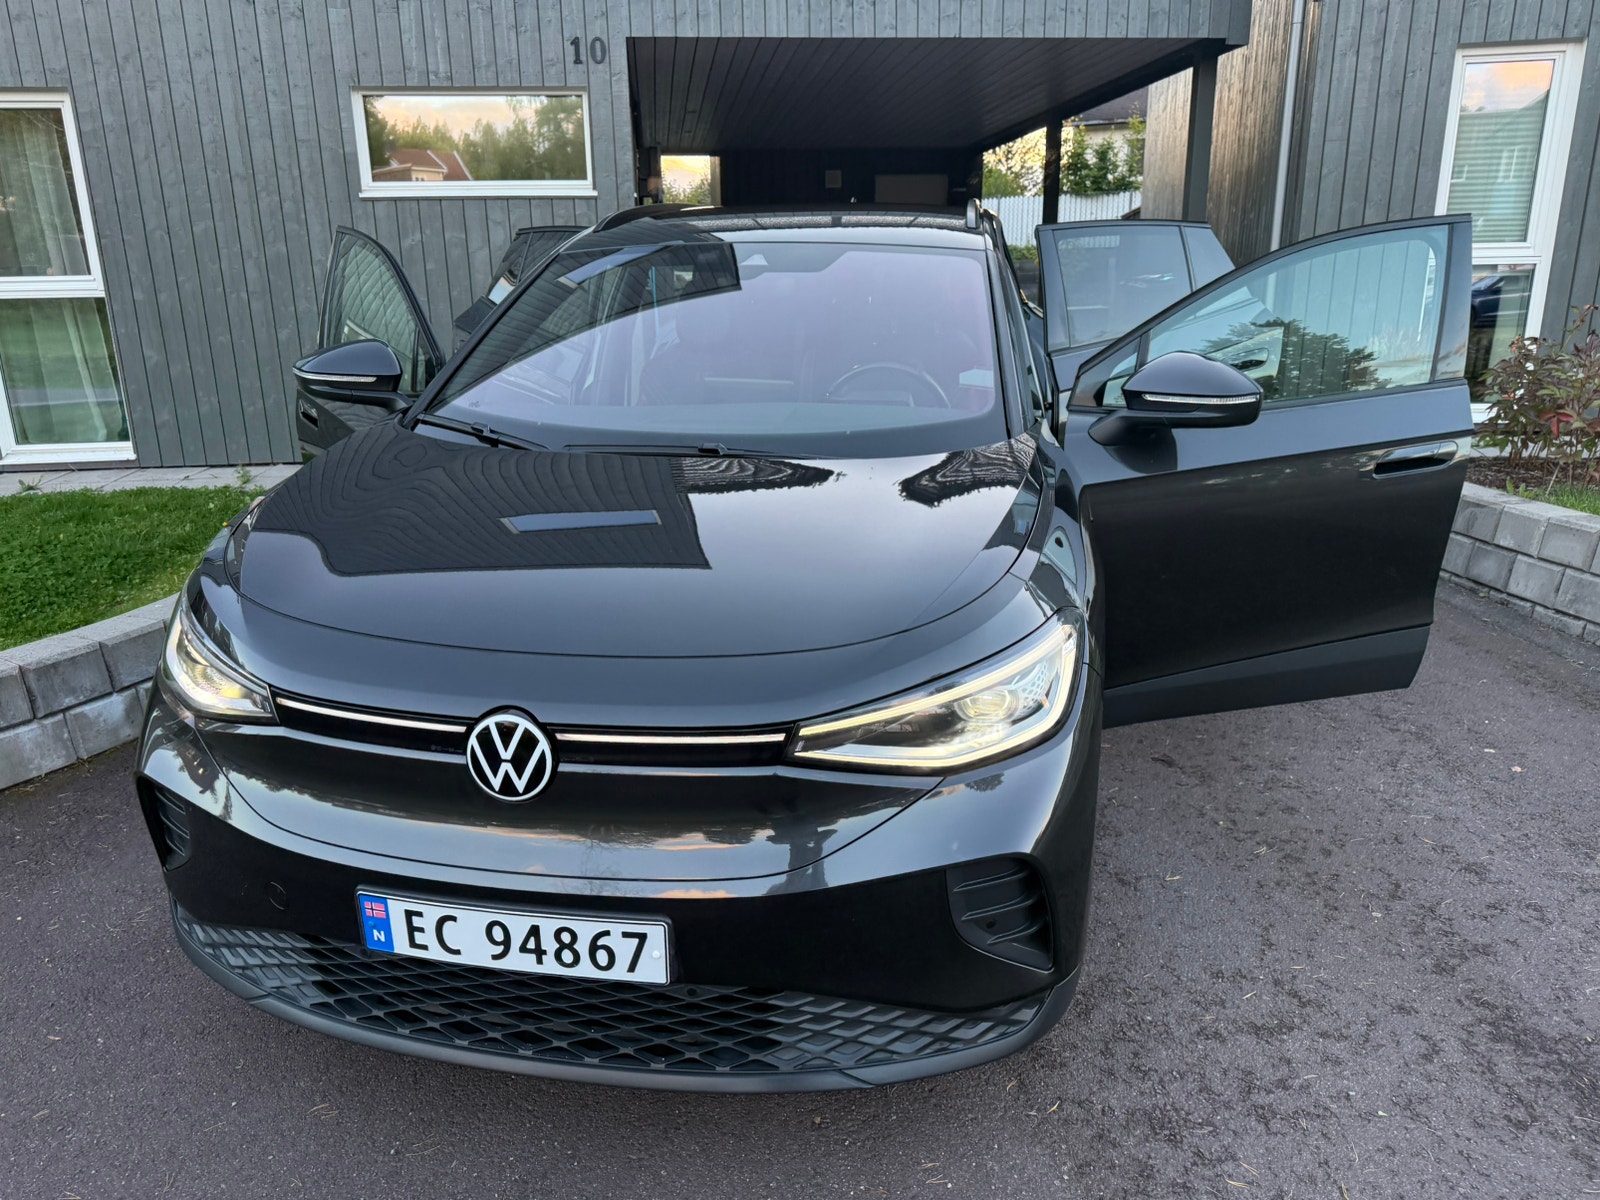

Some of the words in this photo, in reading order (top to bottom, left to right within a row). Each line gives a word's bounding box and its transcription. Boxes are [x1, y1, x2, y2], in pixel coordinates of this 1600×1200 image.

[570, 36, 607, 65] 10
[469, 717, 550, 798] VW
[373, 928, 386, 942] N
[403, 908, 462, 956] EC
[484, 919, 648, 974] 94867
